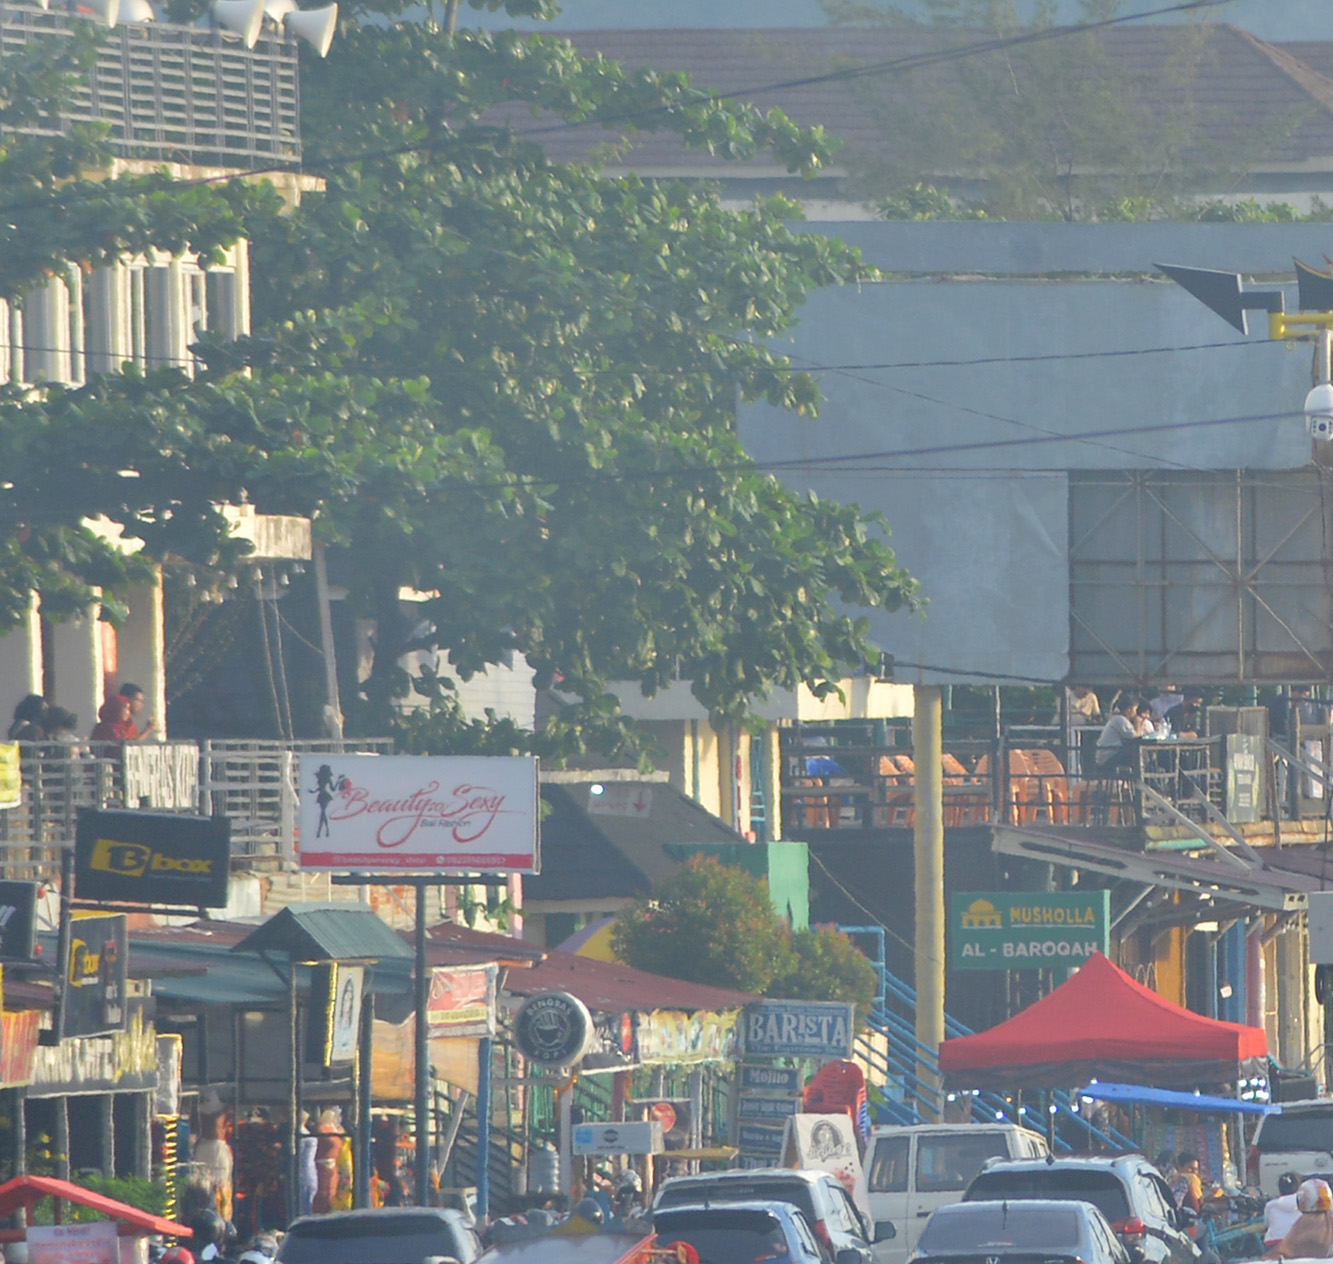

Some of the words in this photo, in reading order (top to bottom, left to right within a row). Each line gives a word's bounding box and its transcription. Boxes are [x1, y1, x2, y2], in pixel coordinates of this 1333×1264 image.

[442, 783, 524, 843] Sexy
[1010, 906, 1096, 924] MUSHOLLA
[962, 942, 986, 957] AL
[1003, 941, 1098, 957] BAROQAH
[749, 1012, 848, 1049] BARISTA
